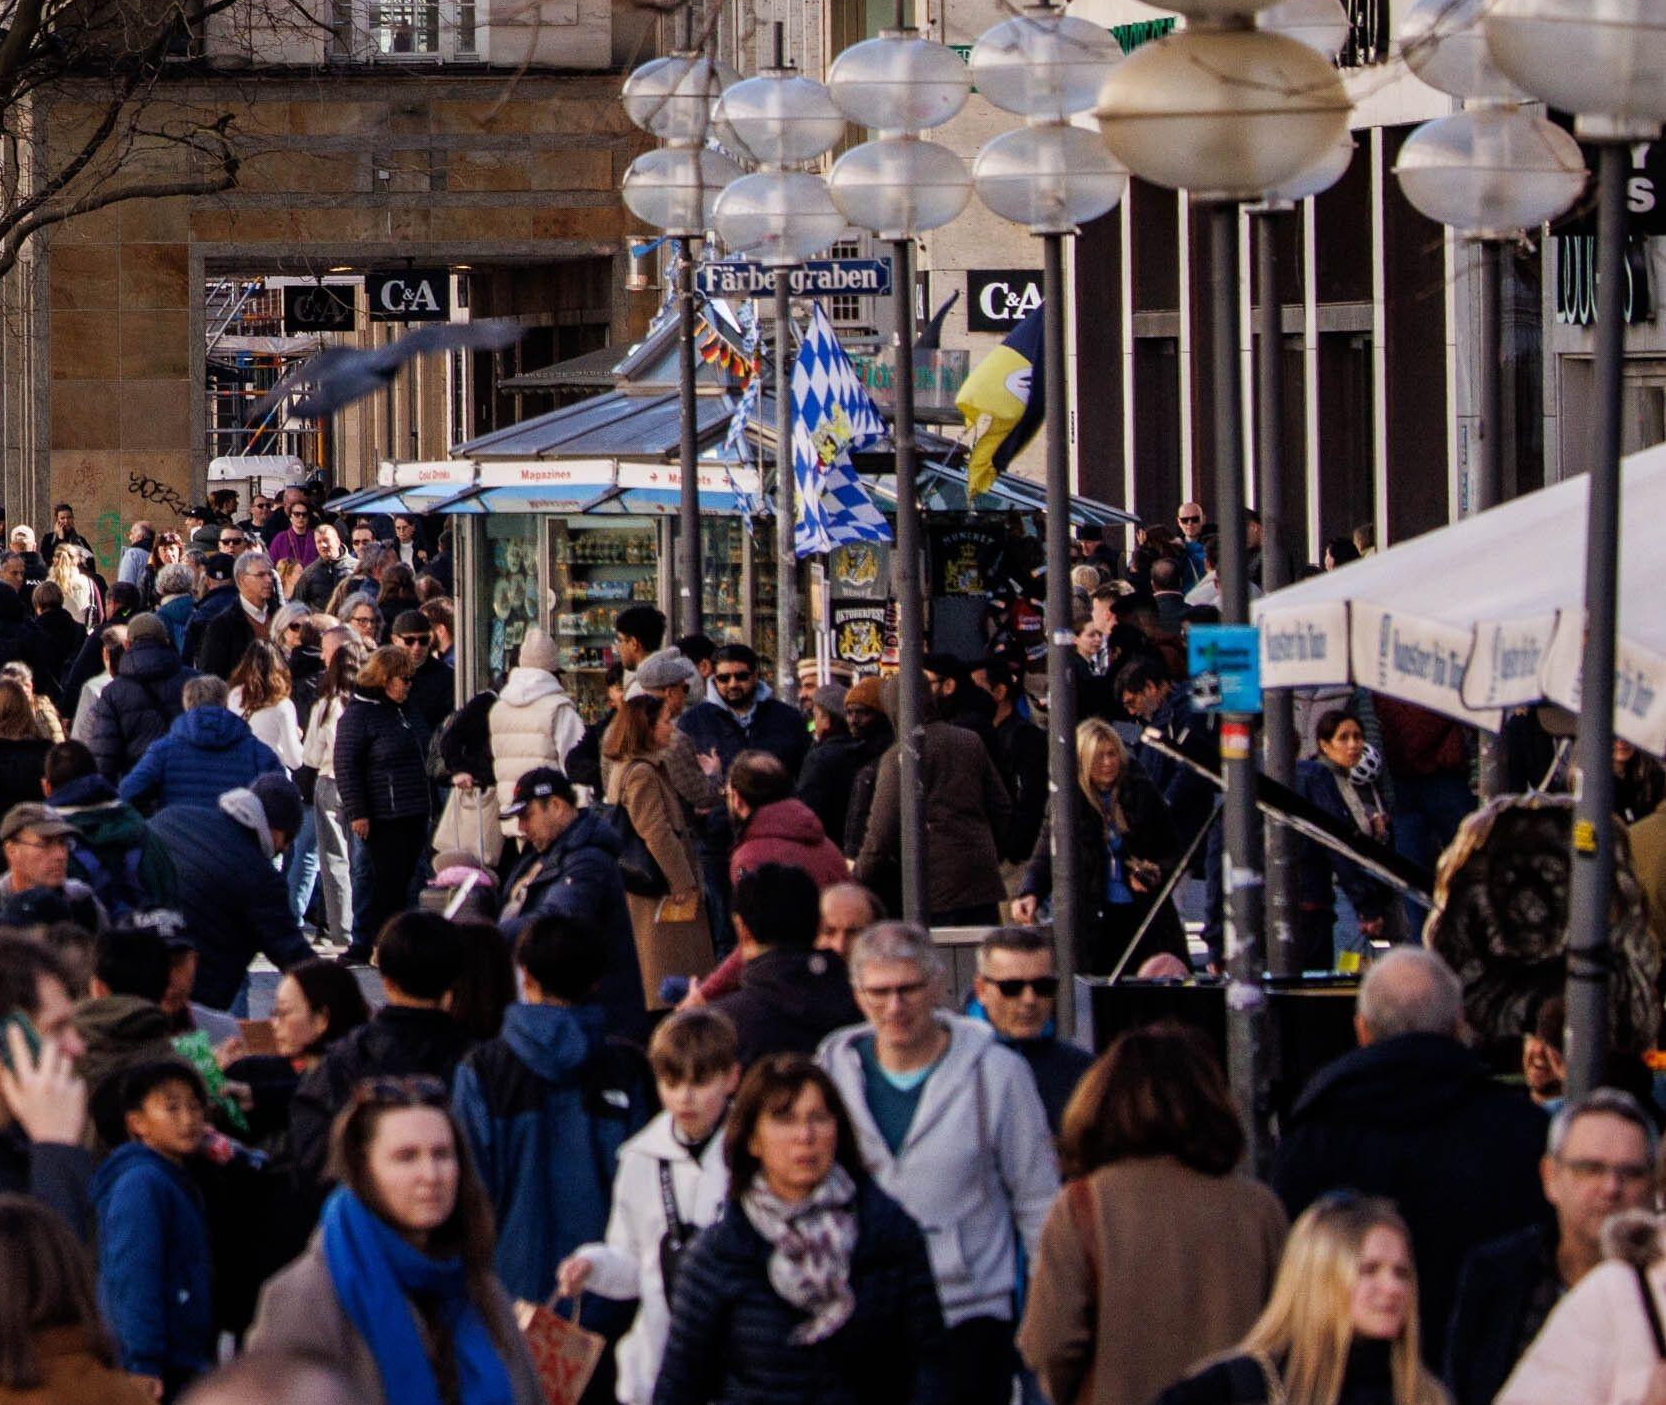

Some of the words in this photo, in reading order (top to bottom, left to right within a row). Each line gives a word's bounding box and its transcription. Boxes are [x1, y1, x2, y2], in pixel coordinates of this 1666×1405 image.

[706, 263, 878, 293] Färbegraben
[380, 279, 441, 312] C&A
[979, 282, 1044, 320] C&A
[521, 469, 572, 481] Magazines
